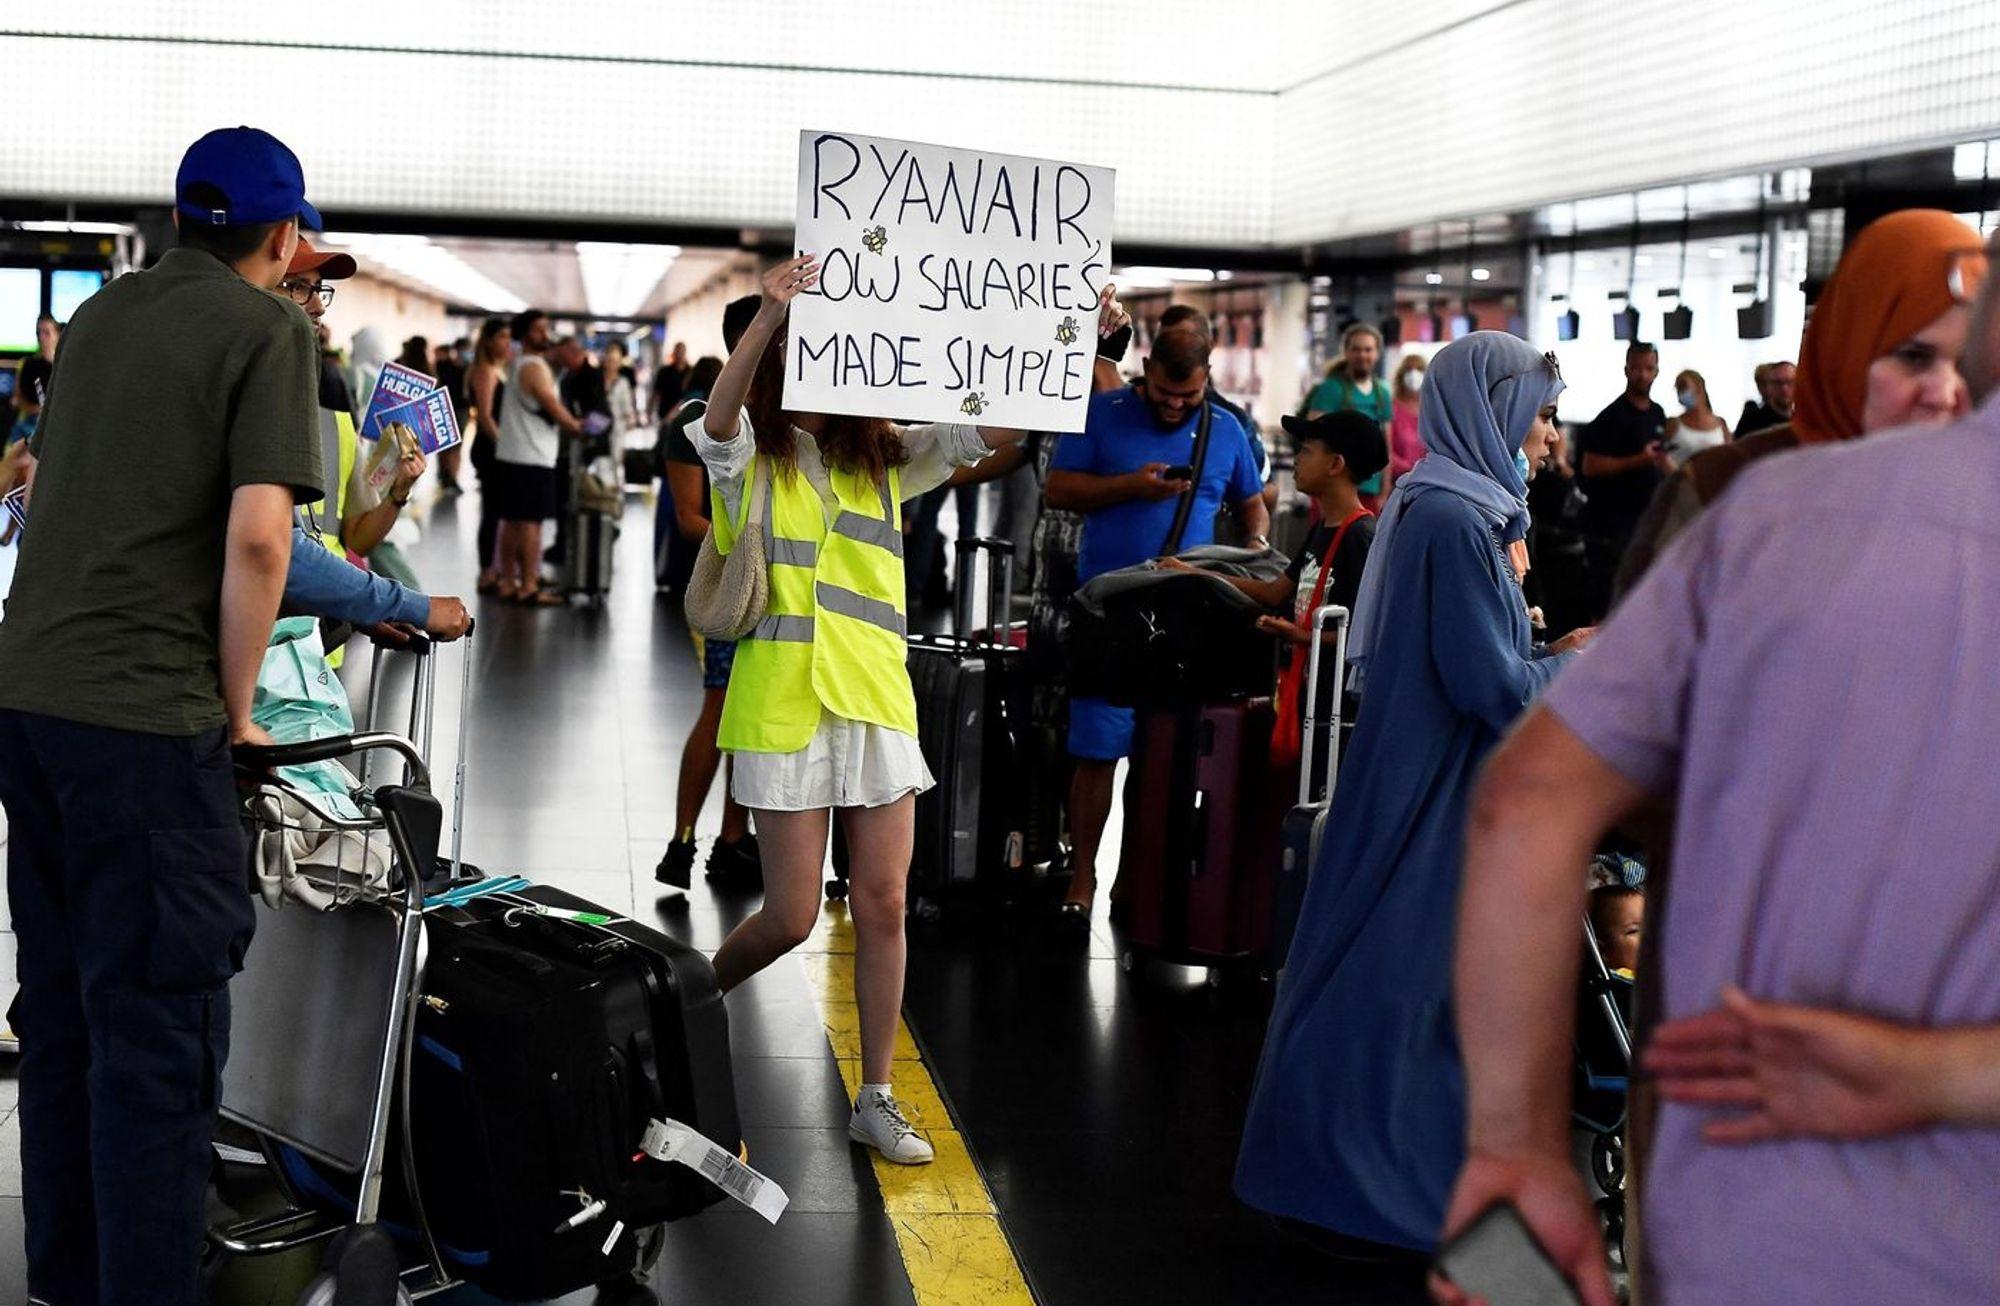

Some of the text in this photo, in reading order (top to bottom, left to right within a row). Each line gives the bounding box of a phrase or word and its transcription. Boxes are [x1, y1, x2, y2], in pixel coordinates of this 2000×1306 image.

[918, 254, 1103, 311] SALARIES
[799, 332, 1085, 400] MADE SIMPLE
[427, 397, 449, 446] HUELGA
